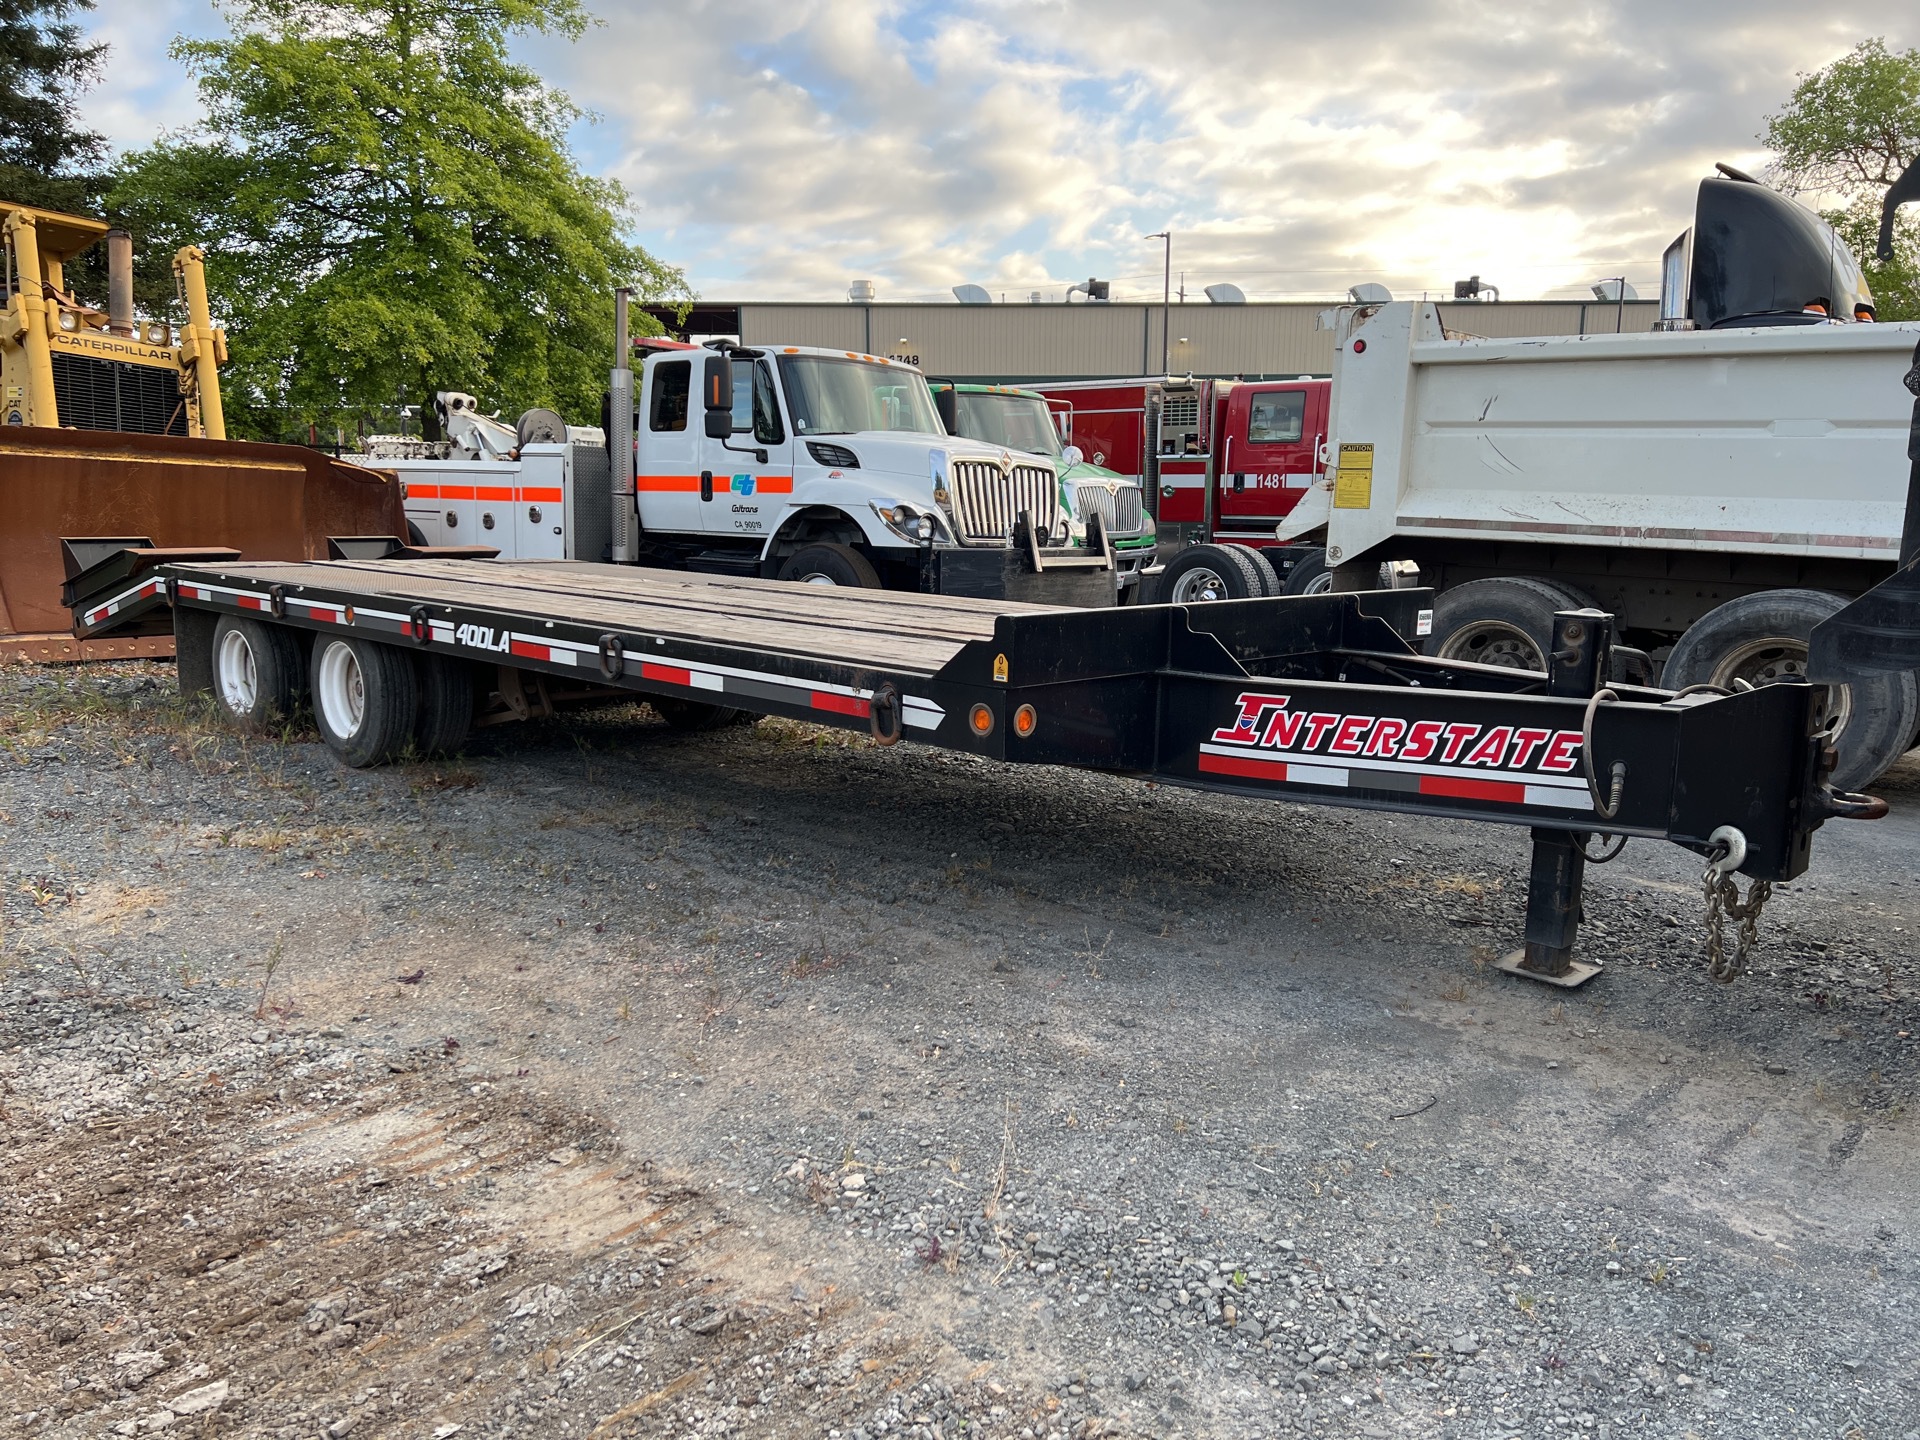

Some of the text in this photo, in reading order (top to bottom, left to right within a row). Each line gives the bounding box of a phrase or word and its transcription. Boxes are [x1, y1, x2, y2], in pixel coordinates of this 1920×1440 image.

[57, 334, 172, 361] CATERPILLAR
[8, 399, 22, 408] CAT
[1342, 444, 1373, 452] CAUTION
[1257, 473, 1286, 489] 1481
[731, 504, 759, 514] Caltrans
[734, 520, 744, 529] CA
[455, 623, 510, 654] 40DLA
[1210, 691, 1584, 773] INTERSTATE
